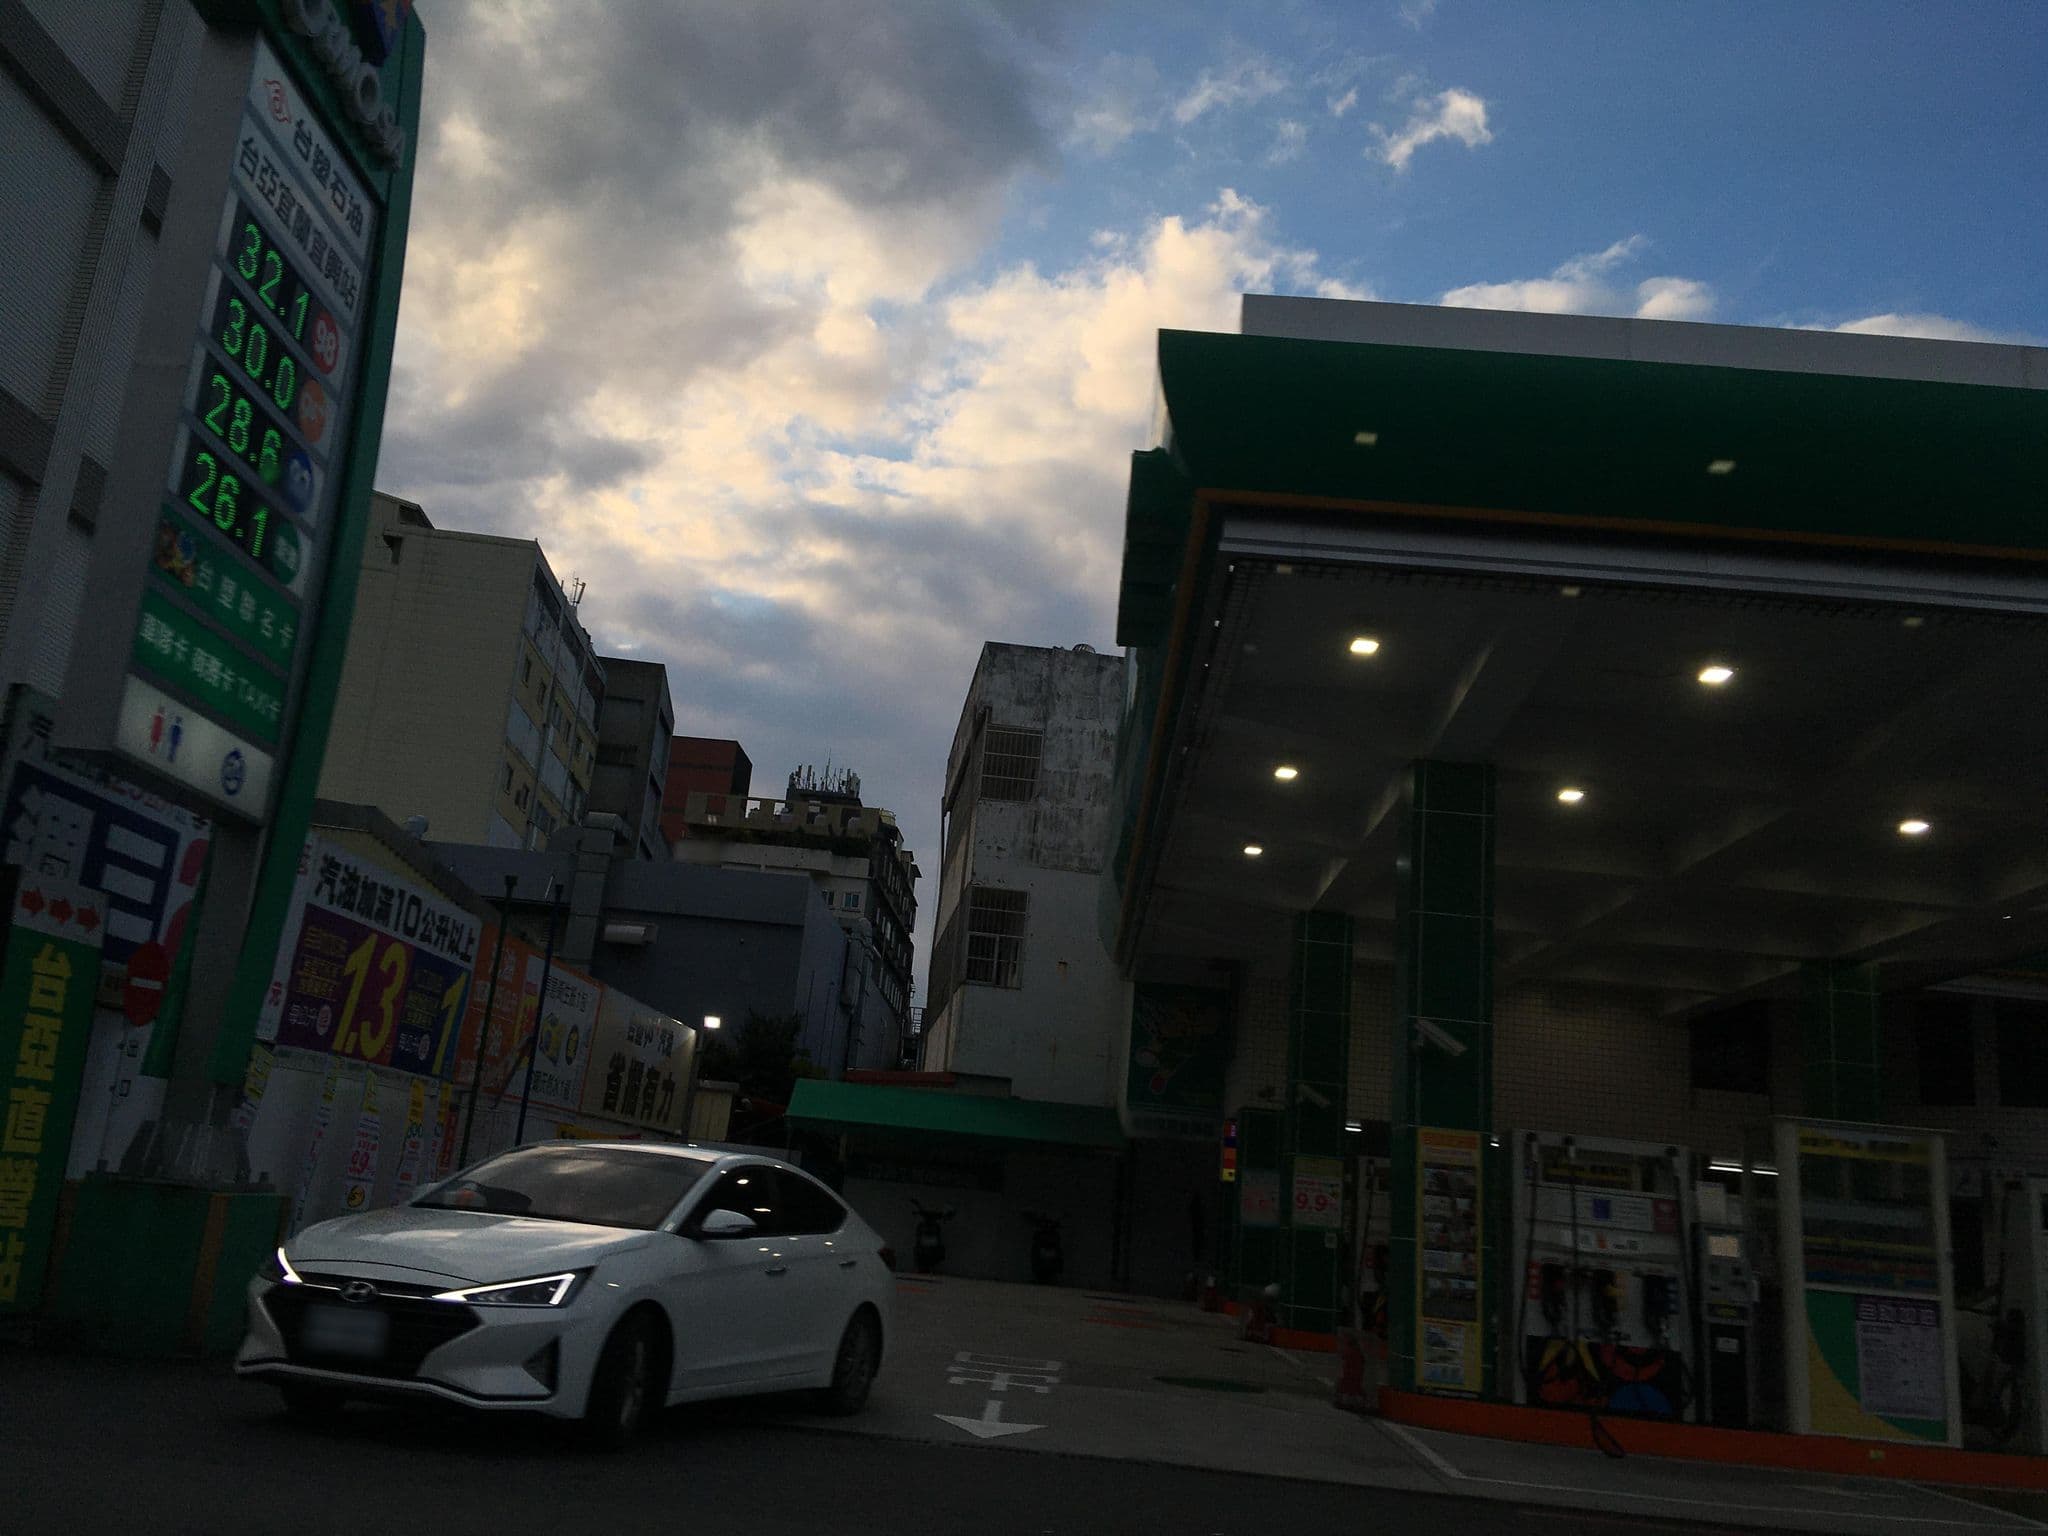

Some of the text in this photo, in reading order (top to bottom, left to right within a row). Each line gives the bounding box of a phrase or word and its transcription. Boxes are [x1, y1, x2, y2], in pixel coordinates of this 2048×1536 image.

[237, 223, 311, 342] 32.1
[222, 298, 297, 410] 30.0
[188, 451, 270, 559] 26.1
[331, 932, 408, 1060] 1.3
